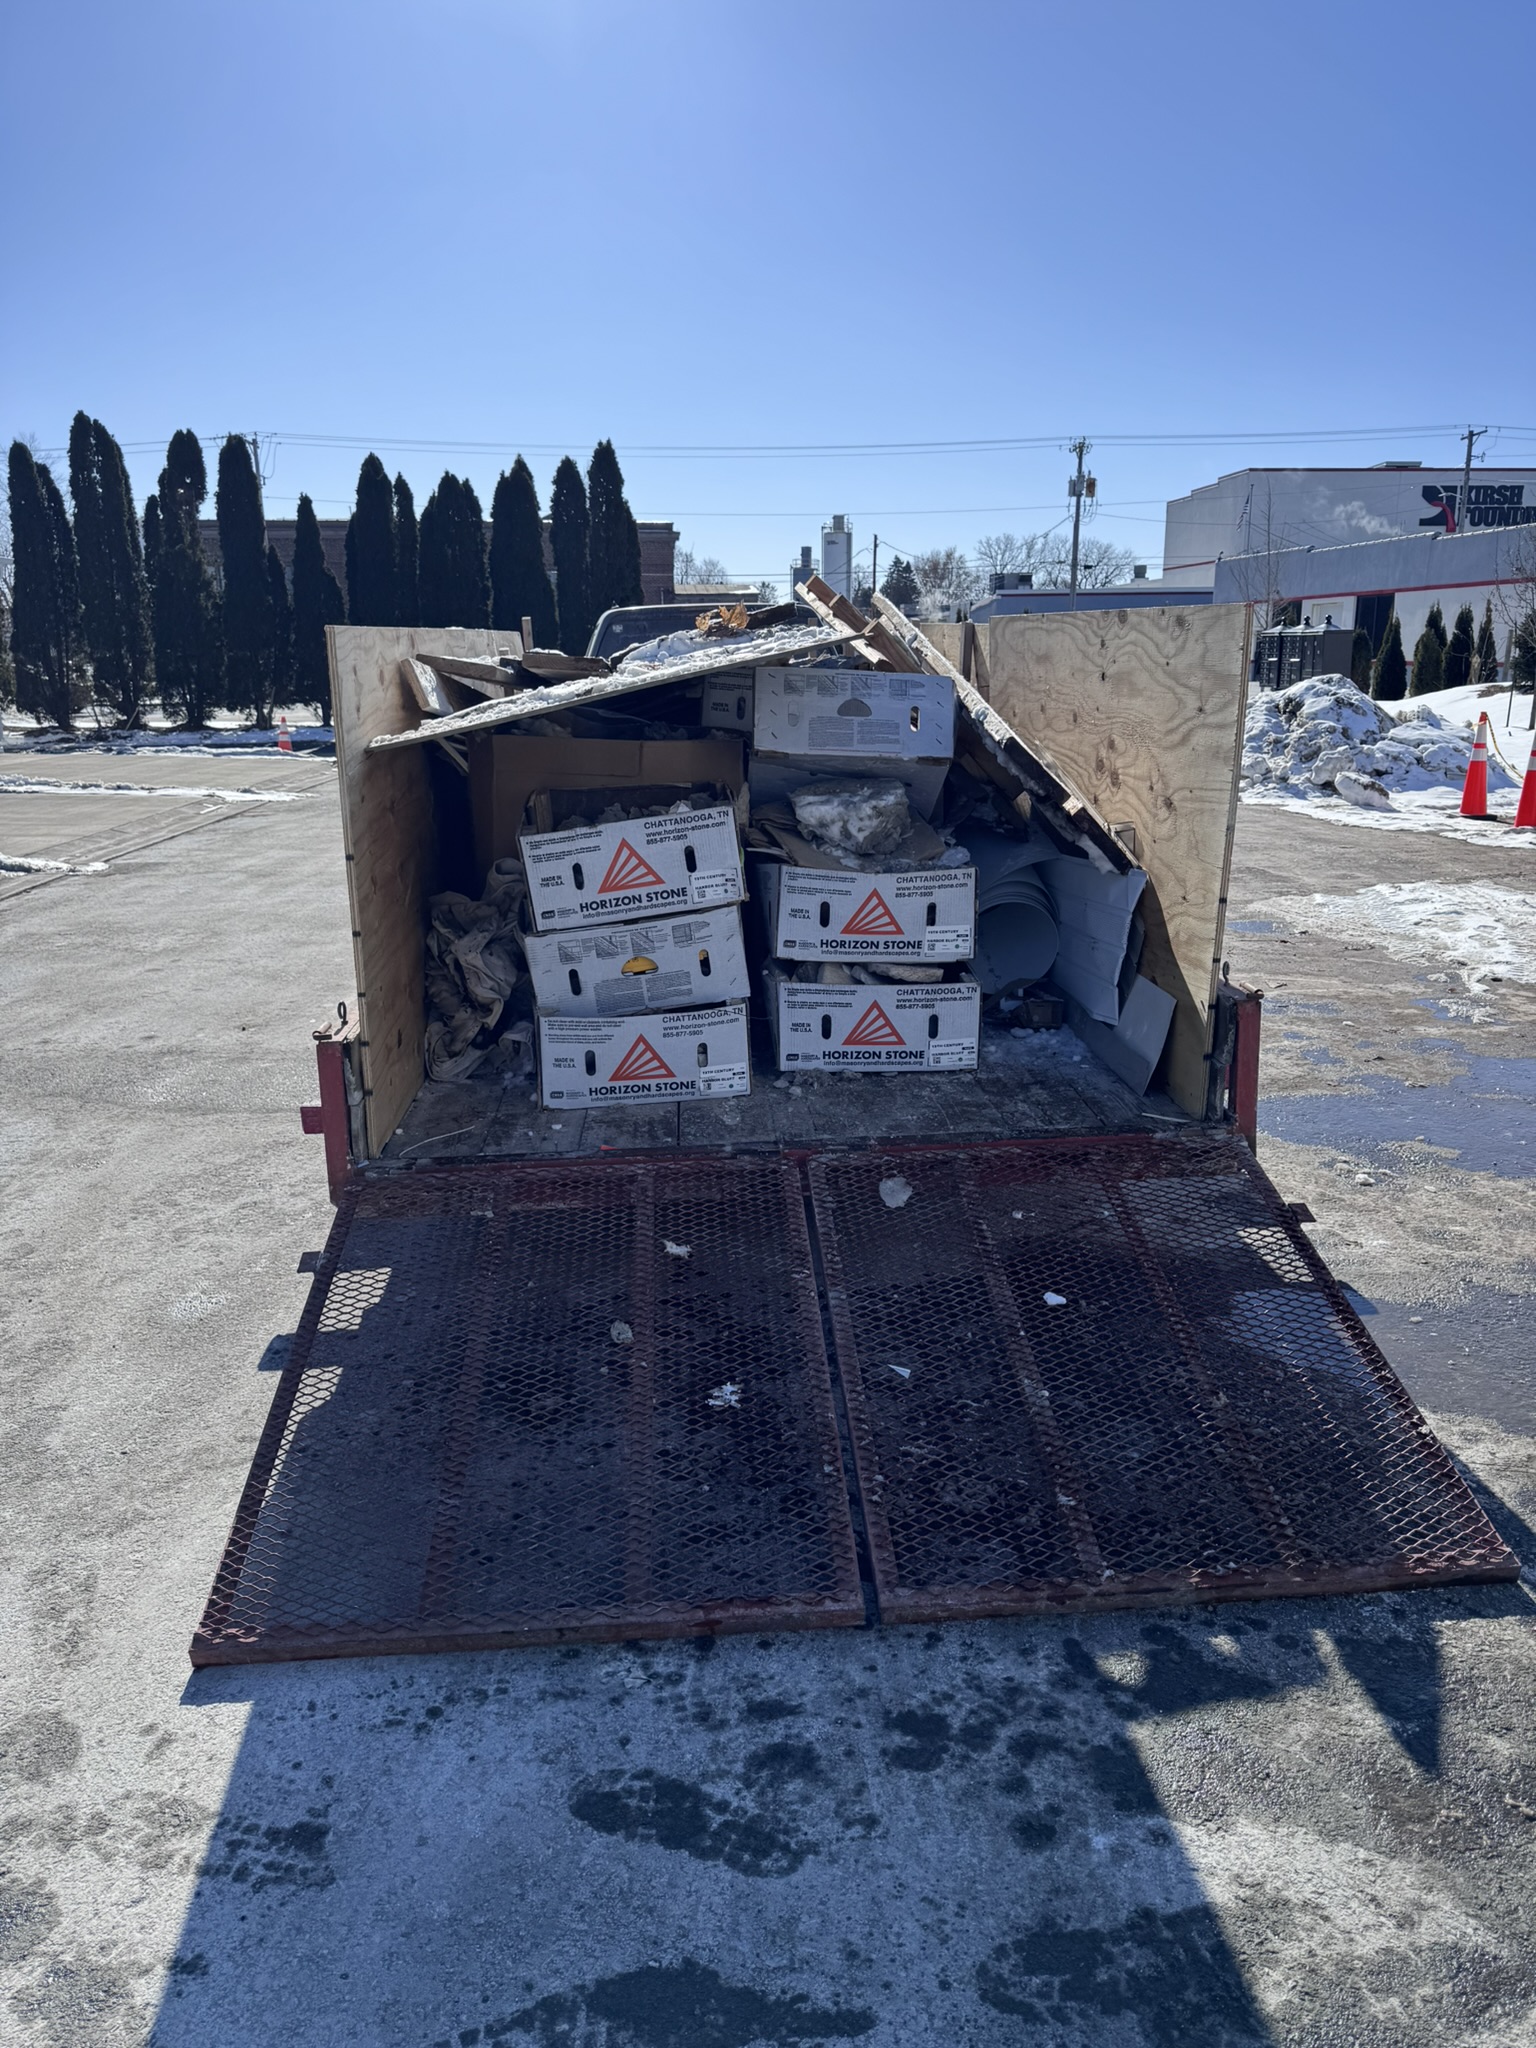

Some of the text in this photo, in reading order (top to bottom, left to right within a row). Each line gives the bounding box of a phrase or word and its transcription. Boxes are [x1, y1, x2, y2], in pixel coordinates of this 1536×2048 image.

[644, 810, 729, 830] CHATTANOOGA, TN
[645, 821, 726, 838] www.horizon-stone.com
[646, 834, 688, 845] 855-877-5905
[896, 873, 960, 884] CHATTANOOGA,
[896, 882, 968, 891] www.horizon-stone.com
[579, 887, 689, 912] HORIZON STONE
[582, 899, 688, 919] info@masonryandhardscapes.org
[820, 939, 880, 950] HORIZON
[883, 940, 923, 950] STONE
[896, 986, 978, 996] CHATTANOOGA, TN
[662, 1007, 743, 1023] CHATTANOOGA, TN
[662, 1017, 740, 1031] www.horizon-stone.com
[662, 1029, 703, 1038] 855-877-5905
[822, 1050, 882, 1060] HORIZON
[885, 1050, 925, 1060] STONE
[589, 1083, 651, 1097] HORIZON
[655, 1080, 697, 1092] STONE
[590, 1090, 695, 1102] info@masonryandhardscapes.org
